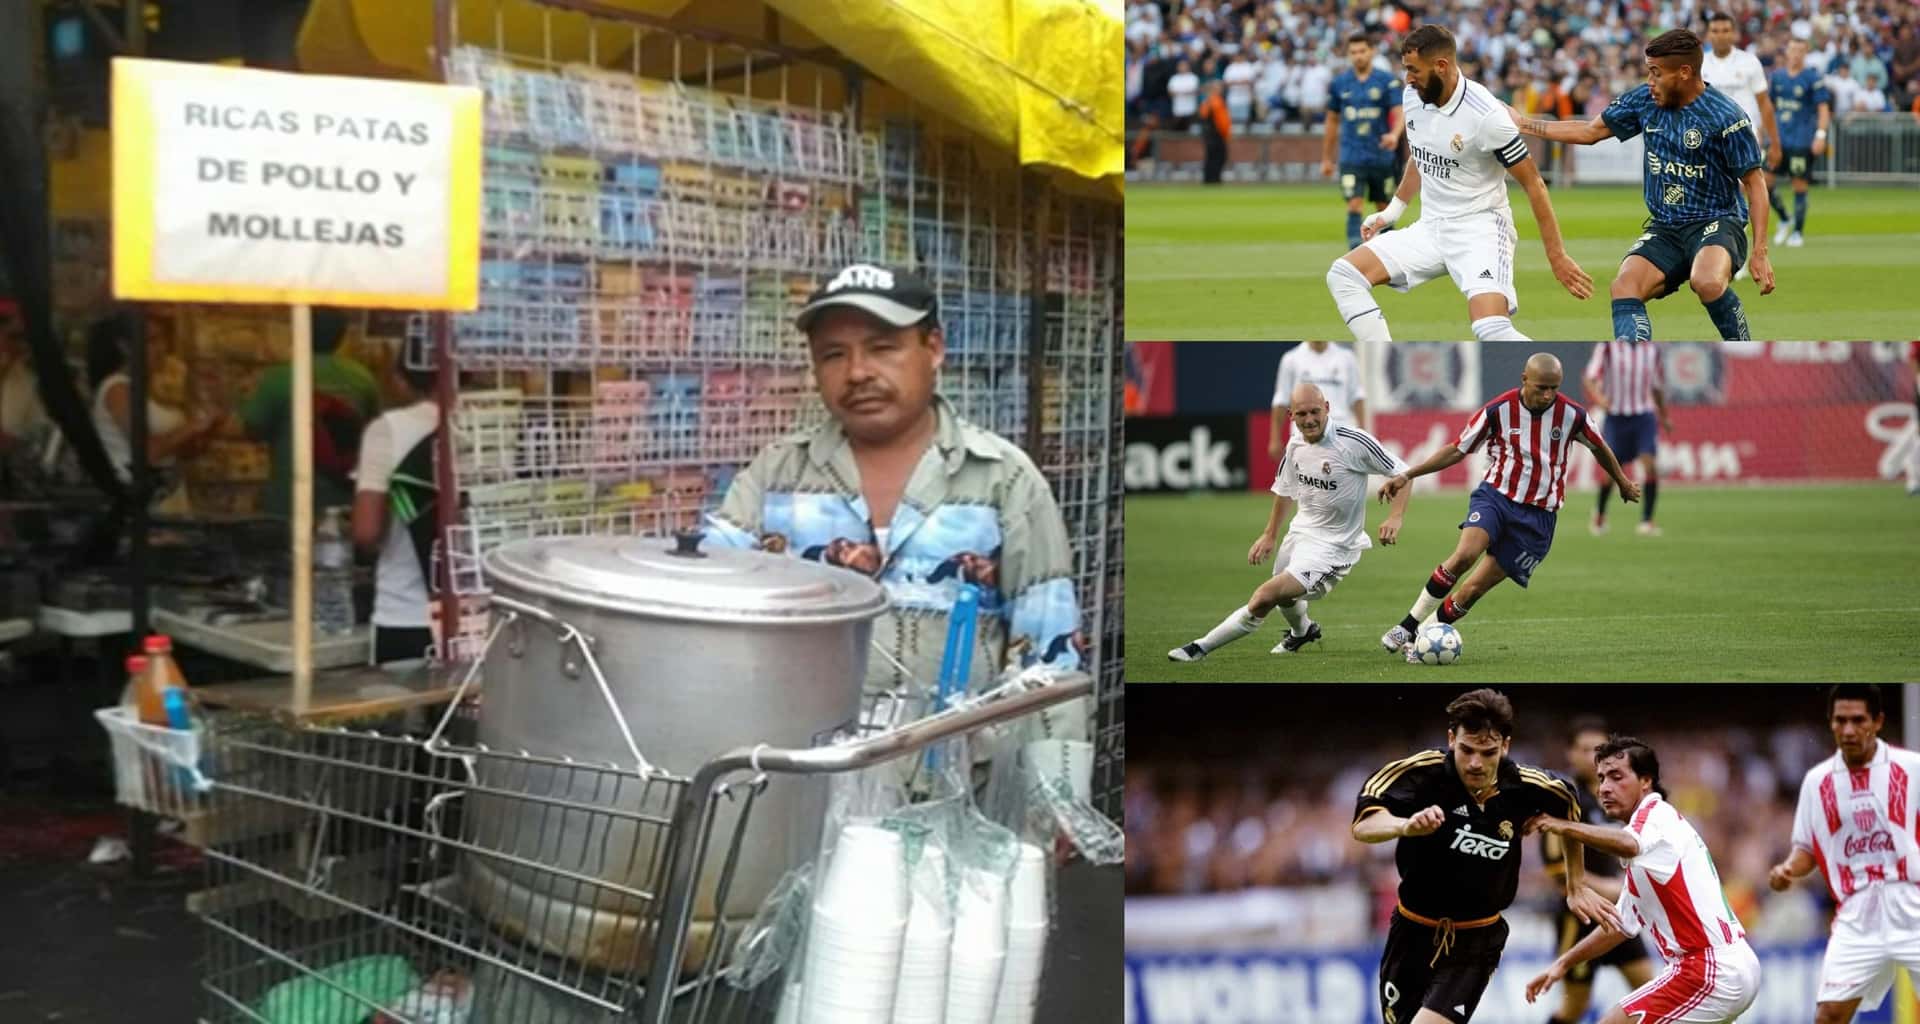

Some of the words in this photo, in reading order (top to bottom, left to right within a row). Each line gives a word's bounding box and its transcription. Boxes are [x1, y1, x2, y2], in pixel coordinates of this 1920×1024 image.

[183, 102, 300, 135] RICAS
[313, 113, 430, 146] PATAS
[1410, 144, 1460, 168] mirates
[1664, 160, 1708, 179] AT&T
[197, 156, 250, 184] DE
[261, 162, 382, 194] POLLO
[393, 171, 417, 196] Y
[207, 211, 406, 248] MOLLEJAS
[1296, 473, 1338, 491] EMENS
[1449, 823, 1510, 860] Teka
[1385, 981, 1400, 1008] 9
